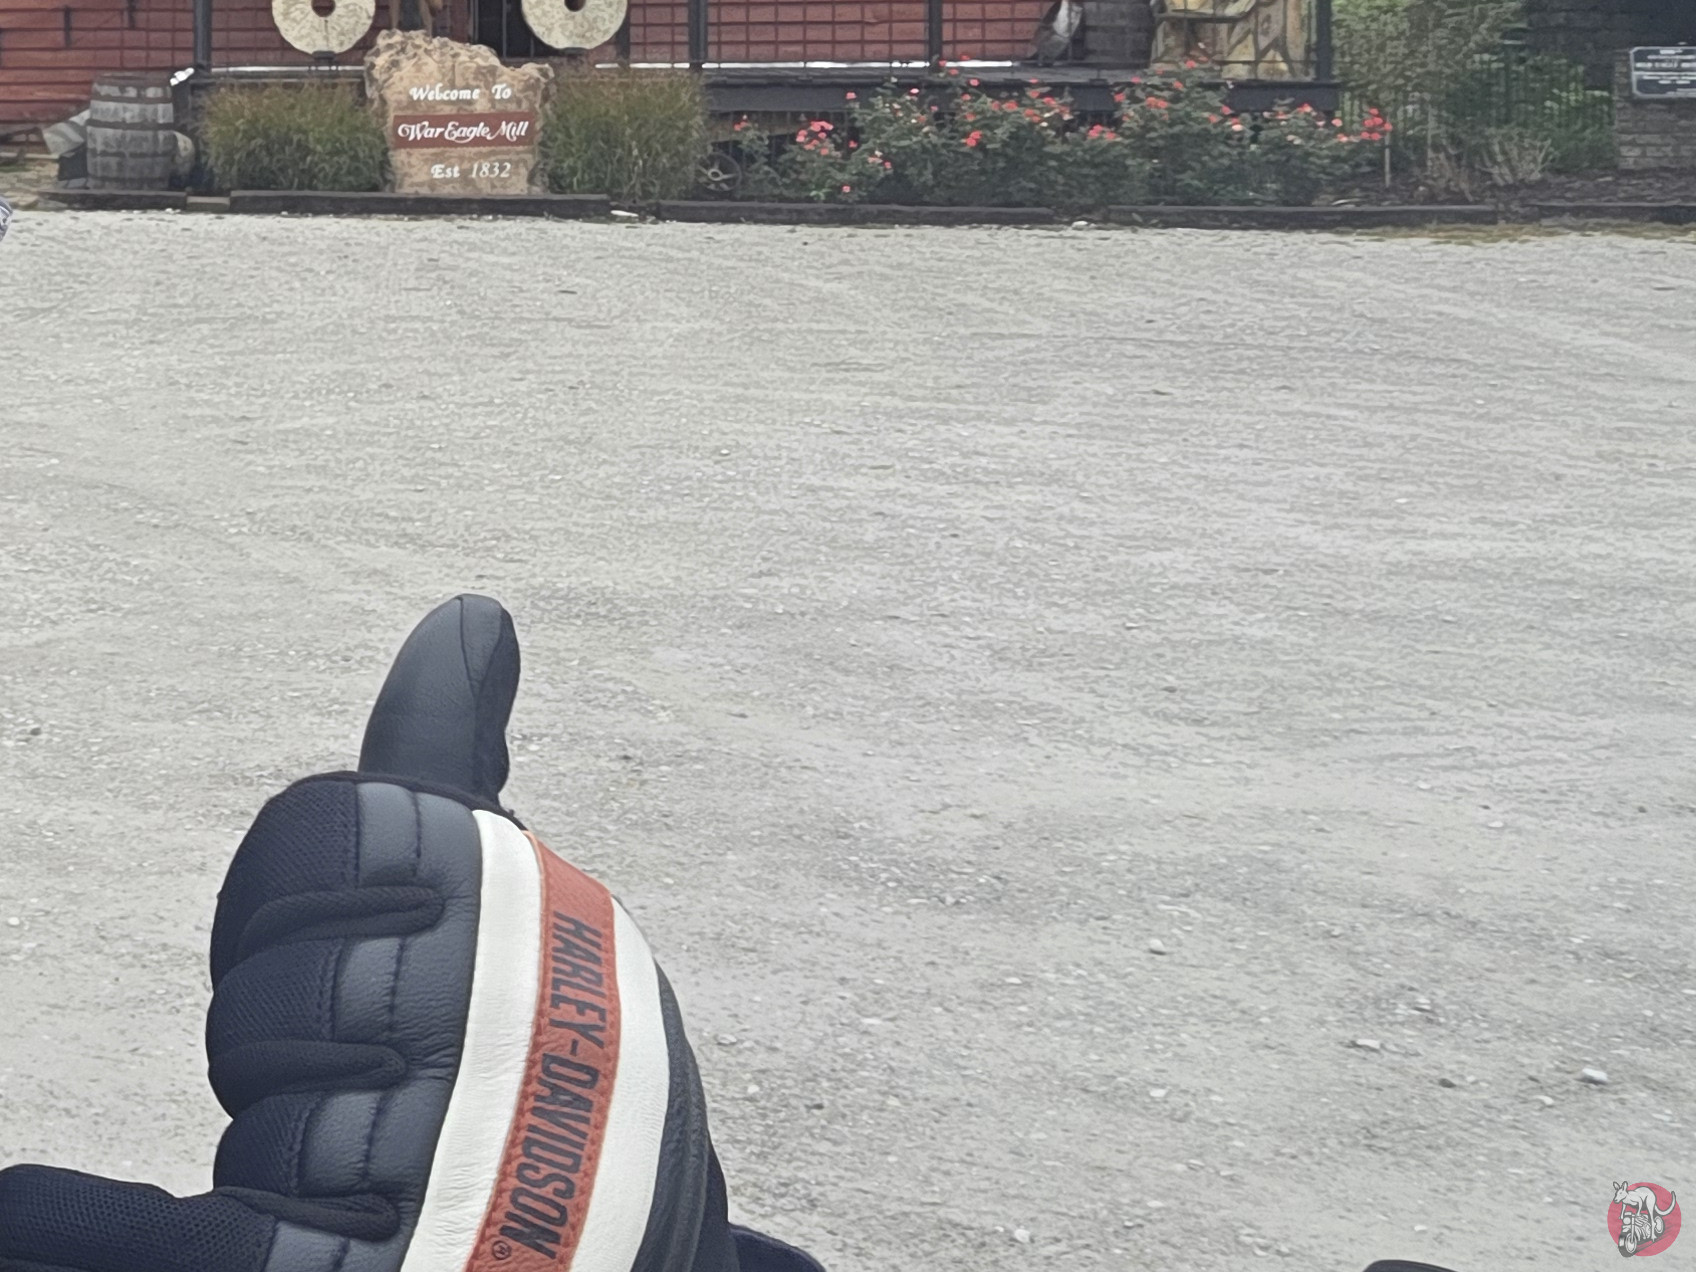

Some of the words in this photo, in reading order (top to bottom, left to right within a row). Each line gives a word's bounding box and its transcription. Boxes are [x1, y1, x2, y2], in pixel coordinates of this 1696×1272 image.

[409, 83, 480, 101] Welcome
[491, 83, 512, 100] To
[398, 121, 444, 141] War
[444, 121, 490, 143] Eagle
[487, 121, 529, 141] Mill
[431, 163, 460, 178] Est
[471, 162, 512, 178] 1832
[499, 910, 607, 1260] HARLEY-DAVIDSON
